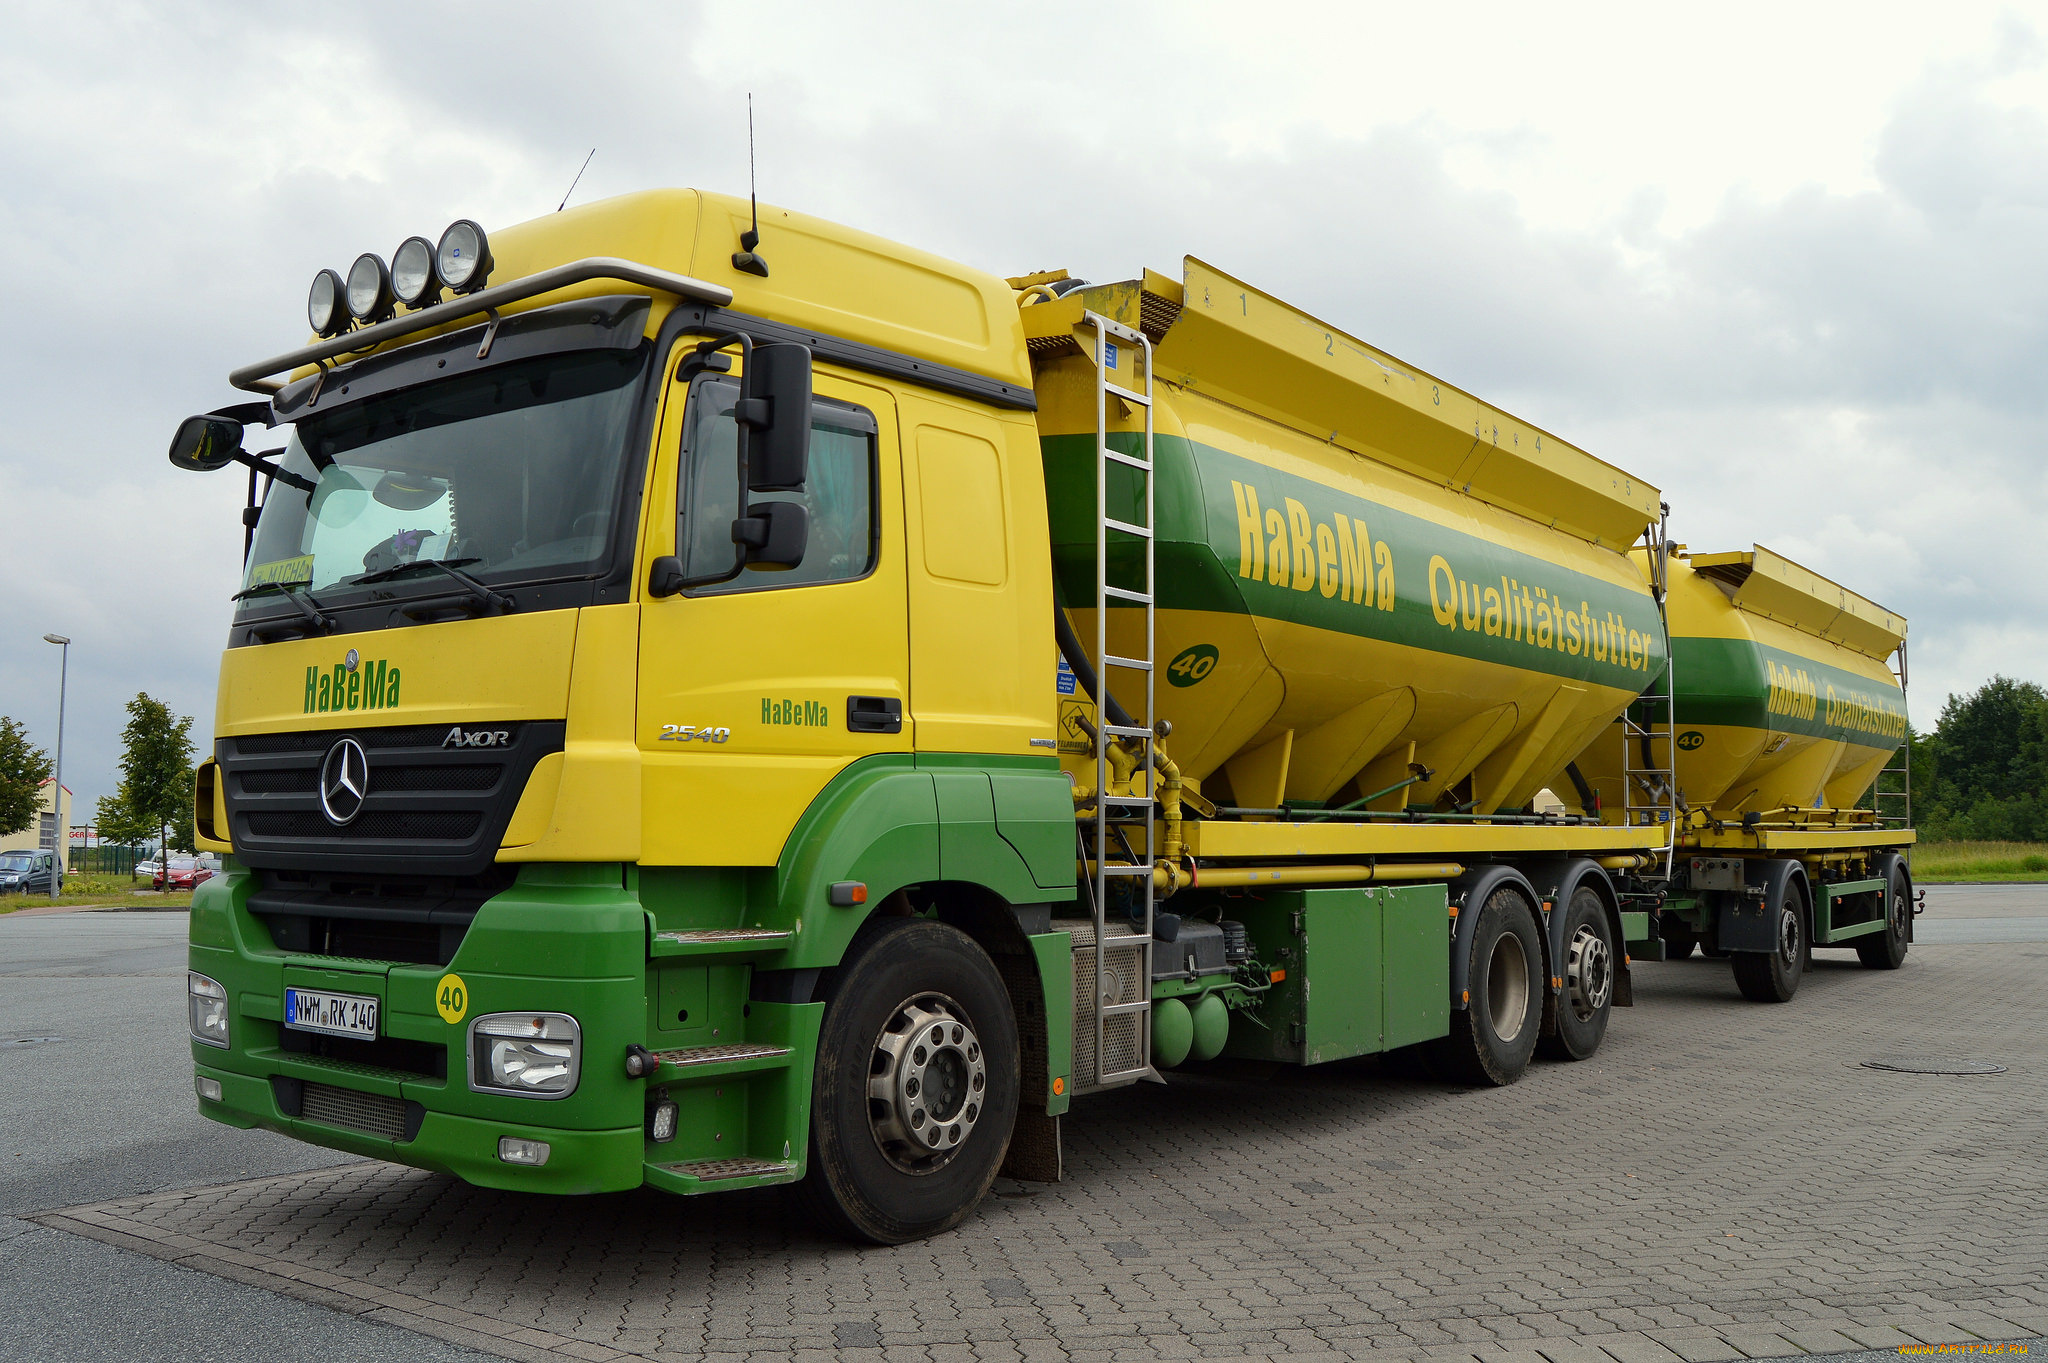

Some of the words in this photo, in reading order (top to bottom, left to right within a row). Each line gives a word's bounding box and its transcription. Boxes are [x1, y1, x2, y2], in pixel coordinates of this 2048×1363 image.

[1239, 293, 1247, 317] 1
[1324, 333, 1334, 357] 2
[1432, 385, 1441, 406] 3
[1534, 435, 1542, 454] 4
[267, 560, 306, 582] MICHA
[1231, 480, 1395, 612] HaBeMa
[1428, 554, 1652, 672] Qualitätsfutter
[1170, 654, 1215, 679] 40
[303, 659, 401, 714] HaBeMa
[1767, 660, 1817, 721] HaBeMa
[1825, 684, 1908, 739] Qualitätsfutter
[761, 697, 828, 727] HaBeMa
[657, 724, 731, 744] 2540
[1678, 735, 1703, 748] 40
[440, 986, 464, 1013] 40
[295, 994, 321, 1024] NWM
[329, 999, 347, 1027] RK
[350, 1002, 376, 1031] 140
